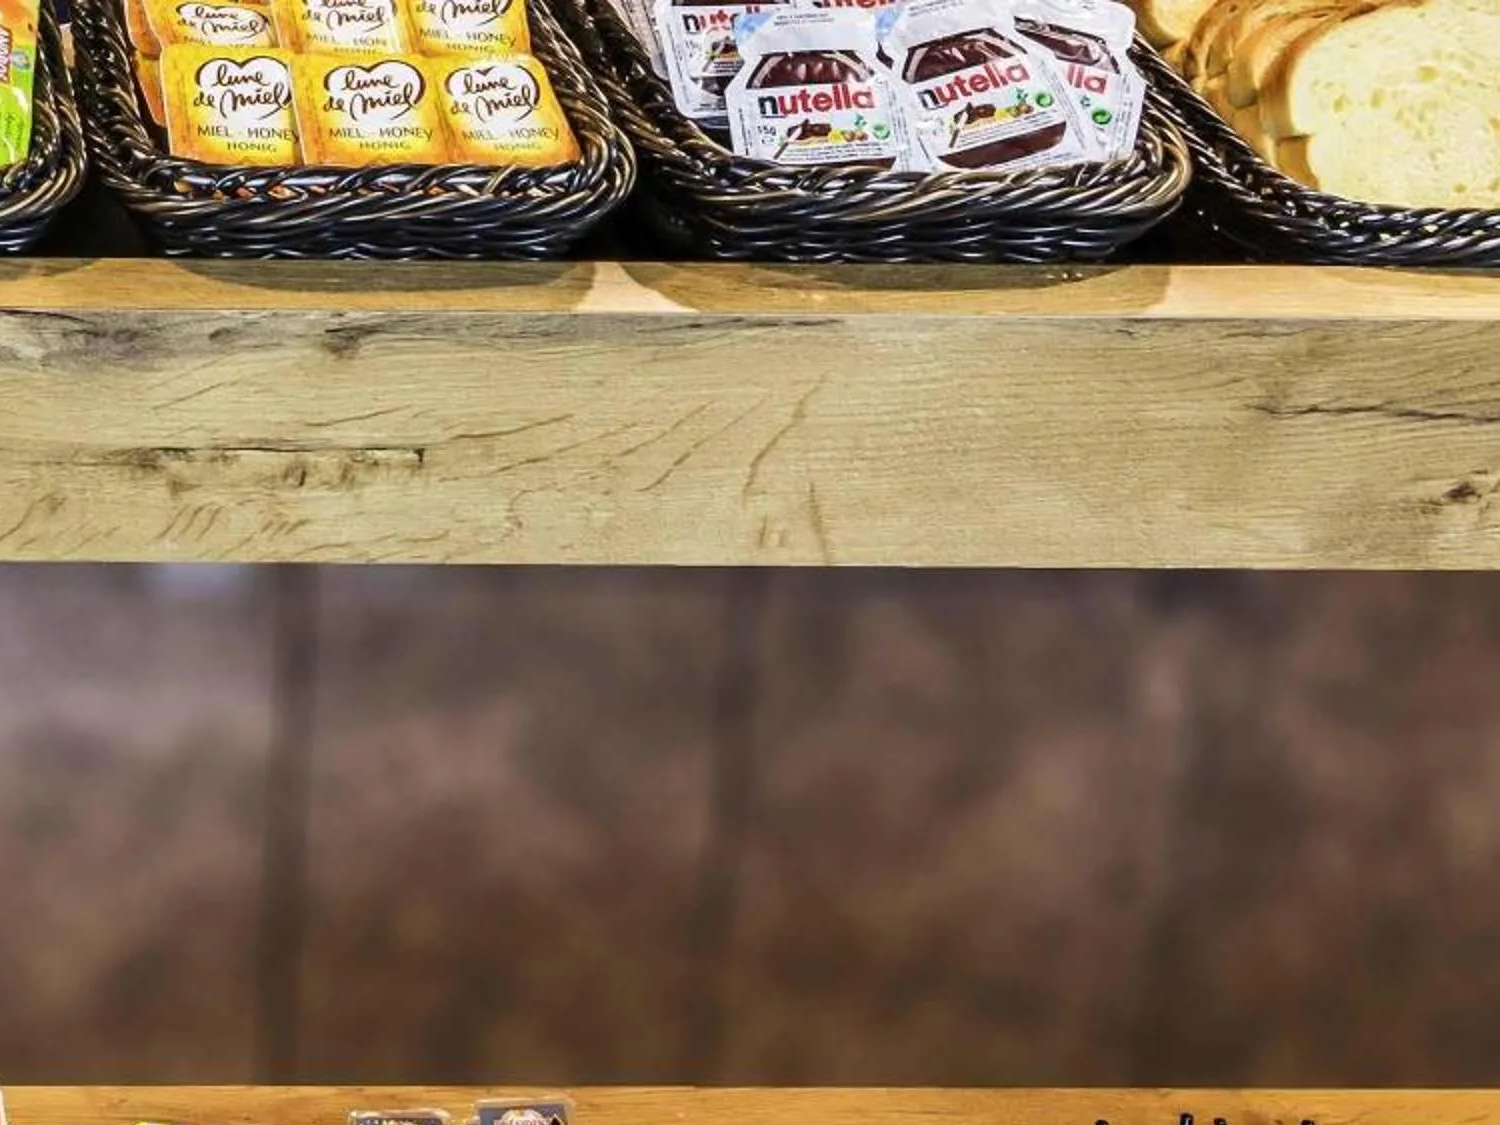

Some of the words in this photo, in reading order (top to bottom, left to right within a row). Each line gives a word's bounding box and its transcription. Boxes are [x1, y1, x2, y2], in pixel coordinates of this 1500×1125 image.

[213, 64, 269, 87] lune
[340, 70, 398, 91] lune
[462, 73, 516, 95] lune
[916, 61, 1031, 109] nutella
[194, 93, 215, 108] de
[219, 82, 286, 120] miel
[323, 97, 344, 111] de
[350, 81, 413, 121] miel
[475, 85, 532, 124] miel
[758, 81, 877, 117] nutella
[197, 125, 232, 138] MIEL
[379, 127, 433, 141] HONEY
